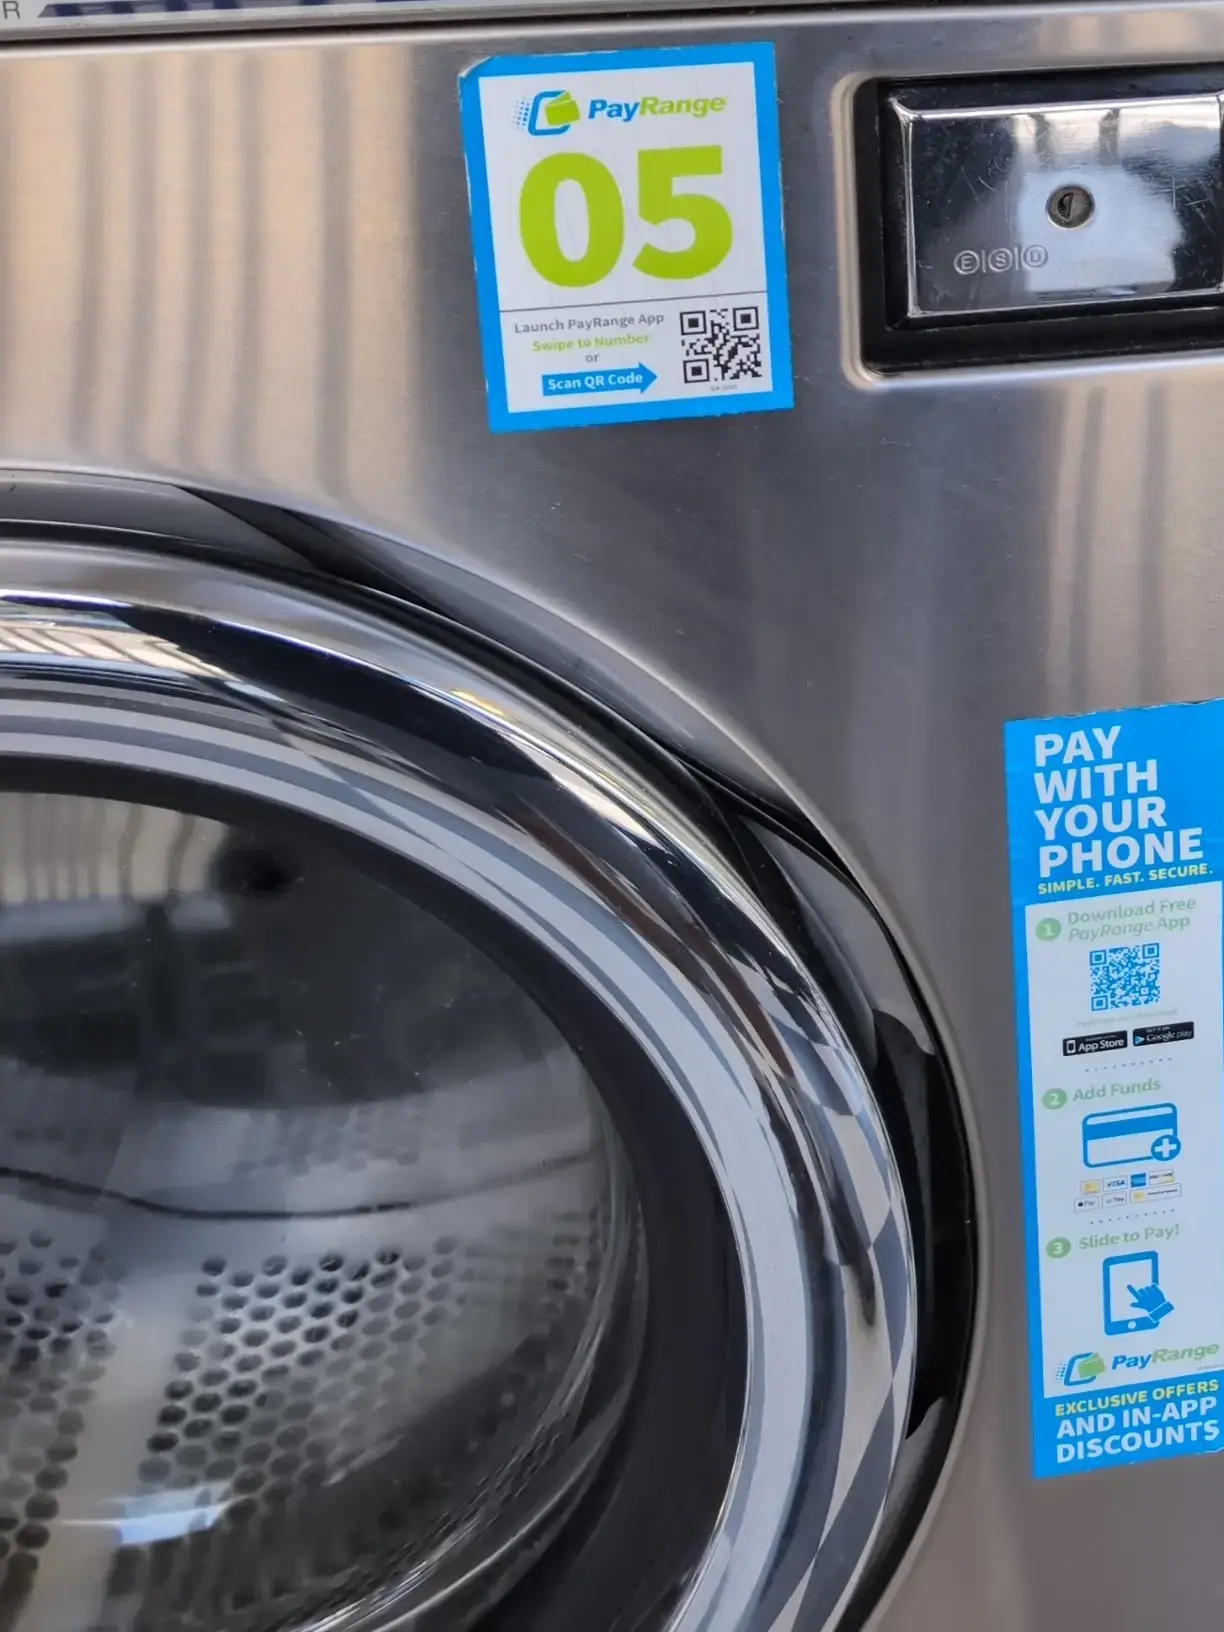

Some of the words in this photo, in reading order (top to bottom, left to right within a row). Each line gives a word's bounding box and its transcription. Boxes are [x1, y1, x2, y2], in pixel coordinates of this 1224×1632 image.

[588, 96, 727, 123] PayRange
[519, 144, 733, 288] 05
[514, 317, 564, 334] Launch
[568, 314, 635, 332] PayRange
[638, 312, 665, 328] App
[532, 337, 573, 354] Swipe
[577, 335, 592, 347] to
[594, 332, 651, 347] Number
[585, 352, 599, 363] or
[548, 376, 581, 390] Scan
[584, 374, 604, 389] QR
[608, 371, 643, 386] Code
[1034, 725, 1122, 767] PAY
[1033, 759, 1159, 805] WITH
[1033, 796, 1168, 841] YOUR
[1038, 827, 1204, 879] PHONE
[1038, 874, 1100, 895] SIMPLE.
[1104, 869, 1145, 887] FAST.
[1148, 863, 1213, 881] SECURE.
[1067, 900, 1155, 925] Download
[1159, 897, 1196, 911] Free
[1068, 919, 1154, 943] PayRange
[1157, 915, 1191, 933] App
[1079, 1042, 1098, 1052] App
[1100, 1039, 1124, 1048] Store
[1072, 1085, 1106, 1102] Add
[1110, 1078, 1162, 1096] Funds
[1107, 1179, 1126, 1187] VISA
[1080, 1234, 1120, 1250] Slide
[1124, 1232, 1140, 1244] to
[1144, 1223, 1180, 1240] Pay!
[1112, 1343, 1220, 1371] PayRange
[1055, 1391, 1148, 1416] EXCLUSIVE
[1152, 1379, 1219, 1401] OFFERS
[1056, 1414, 1115, 1439] AND
[1122, 1396, 1217, 1429] IN-APP
[1056, 1420, 1220, 1464] DISCOUNTS
